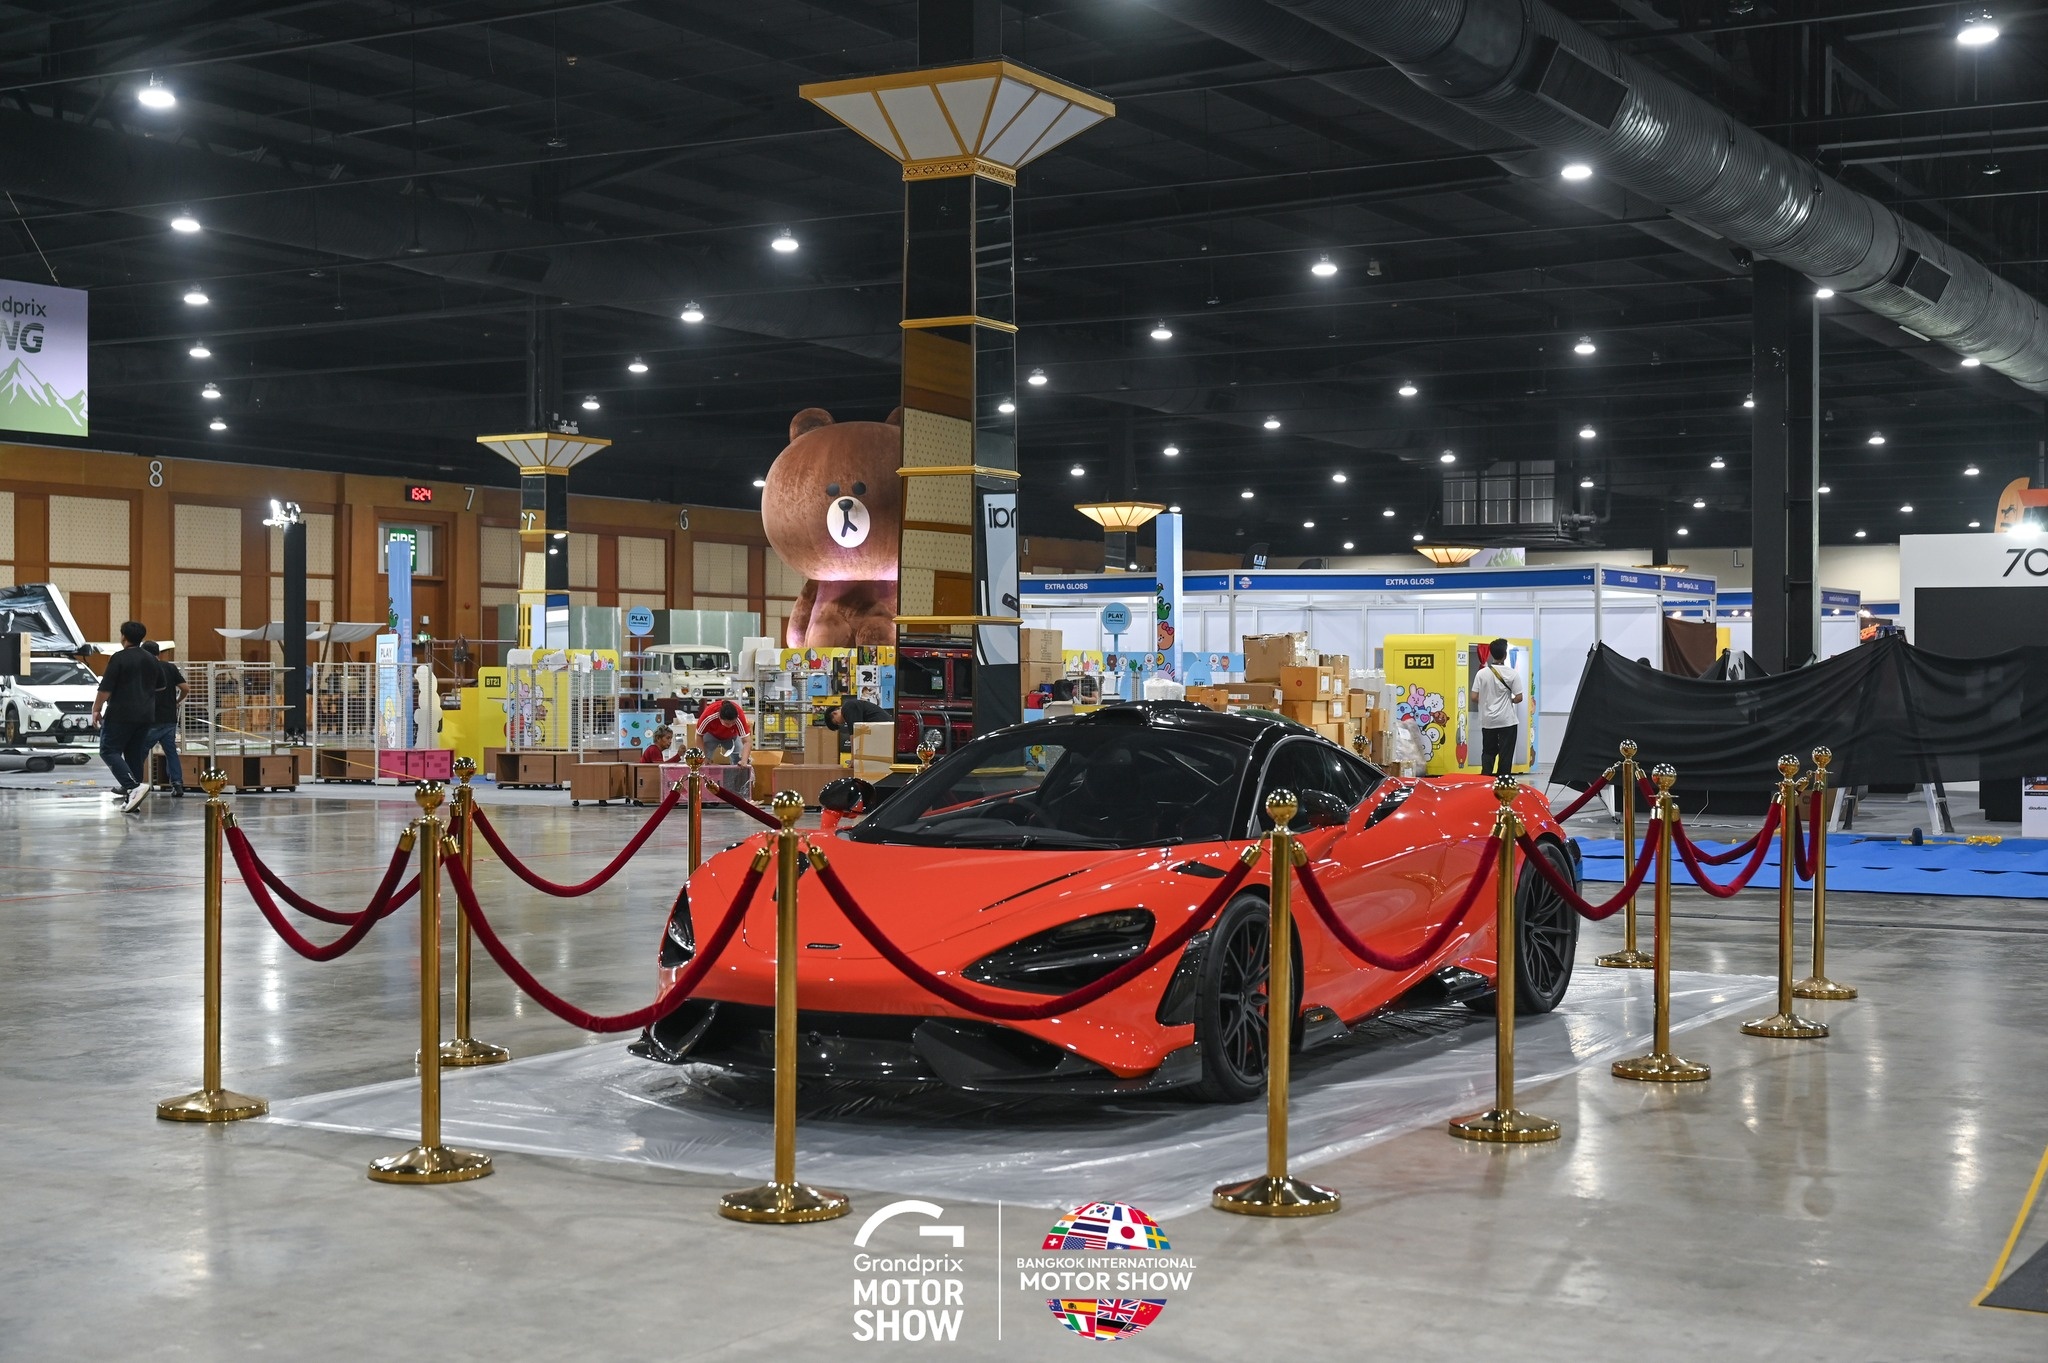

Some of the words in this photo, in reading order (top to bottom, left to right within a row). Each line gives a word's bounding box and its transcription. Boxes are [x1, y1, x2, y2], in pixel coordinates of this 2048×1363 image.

[0, 296, 47, 318] dprix
[149, 460, 163, 488] 8
[464, 486, 475, 511] 7
[679, 508, 689, 531] 6
[1023, 538, 1029, 556] 4
[1733, 550, 1744, 568] L
[1385, 578, 1409, 586] EXTRA
[1410, 577, 1435, 585] GLOSS
[1108, 612, 1124, 620] PLAY
[380, 647, 393, 658] PLAY
[1407, 656, 1432, 667] BT21
[486, 677, 500, 687] BT21
